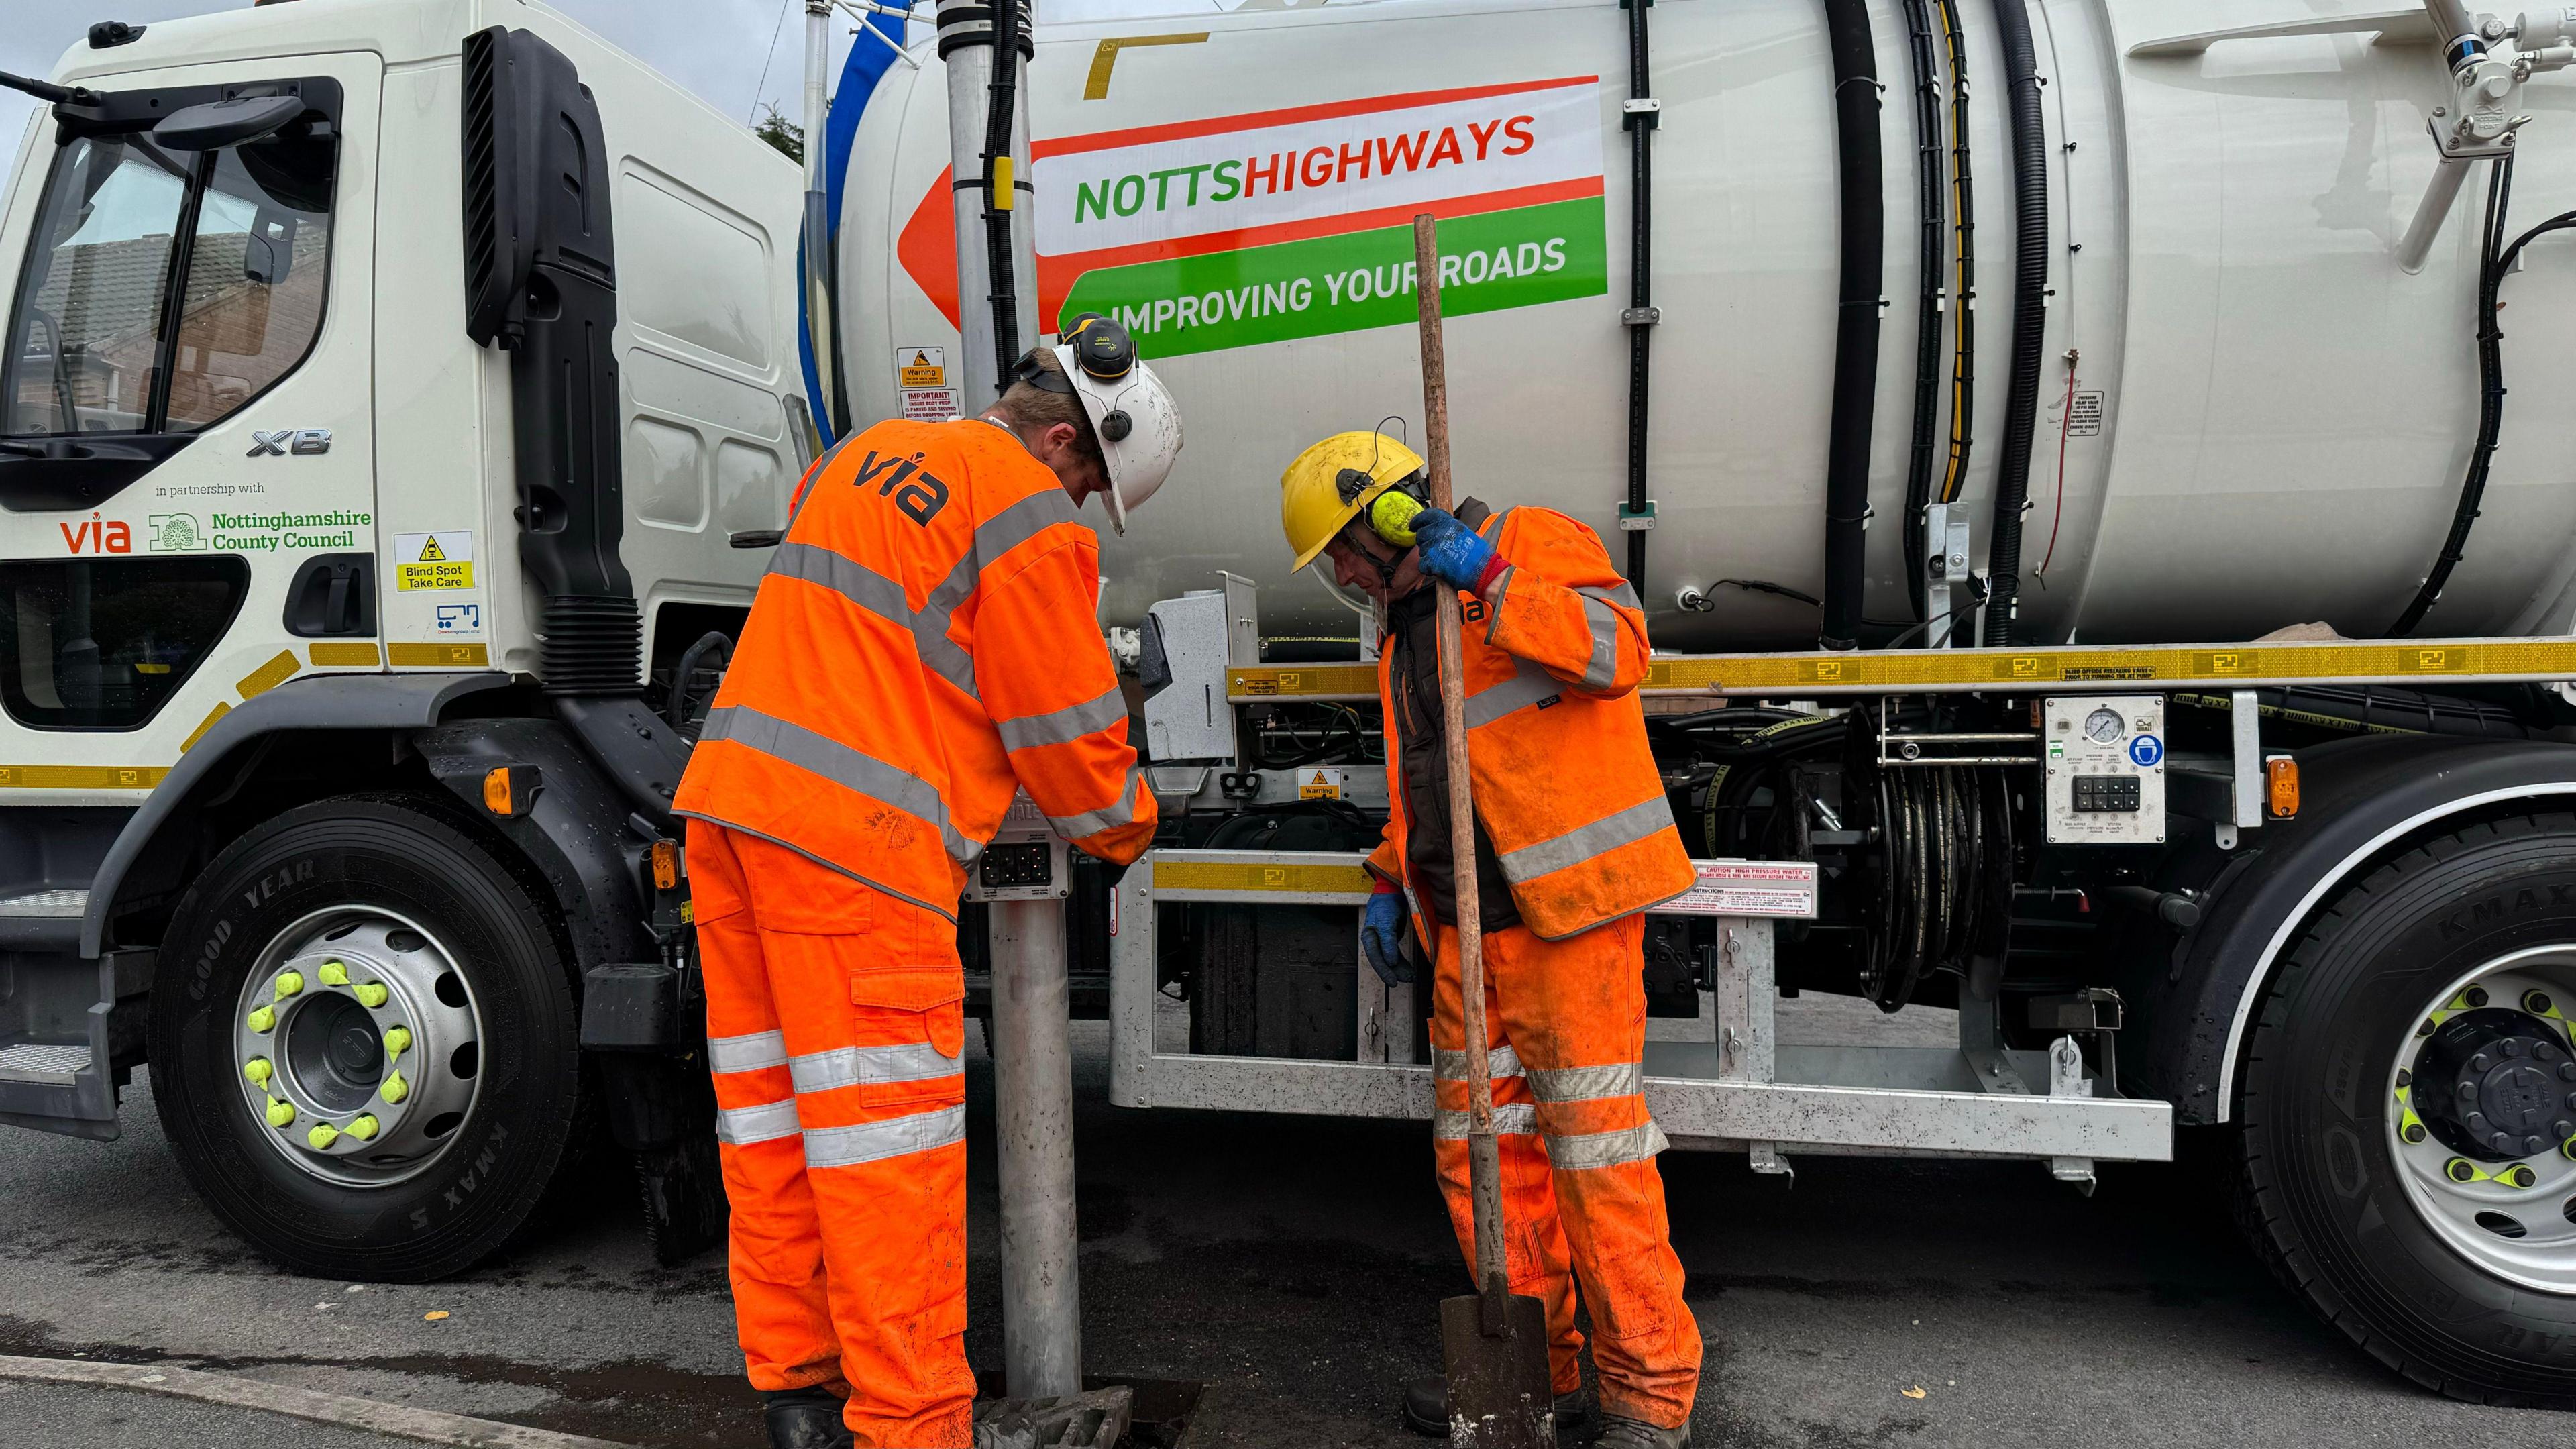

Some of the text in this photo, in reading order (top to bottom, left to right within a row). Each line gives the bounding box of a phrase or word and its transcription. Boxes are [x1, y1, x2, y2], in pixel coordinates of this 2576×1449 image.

[1074, 115, 1535, 223] NOTTSHIGHWAYS
[1438, 237, 1567, 289] ROADS
[907, 368, 936, 376] Warning
[908, 392, 950, 400] IMPORTANT!
[156, 482, 264, 498] in partnership with
[853, 450, 949, 528] via
[59, 511, 131, 554] via
[211, 509, 372, 531] Nottinghamshire
[212, 531, 354, 552] County Council
[406, 566, 462, 577] Blind Spot
[407, 577, 462, 588] Take Care
[1459, 600, 1485, 625] ia
[2438, 883, 2575, 940] KMAX
[189, 859, 315, 1001] GOOD YEAR
[443, 1121, 509, 1211] KMAX
[2495, 1321, 2576, 1359] EAR
